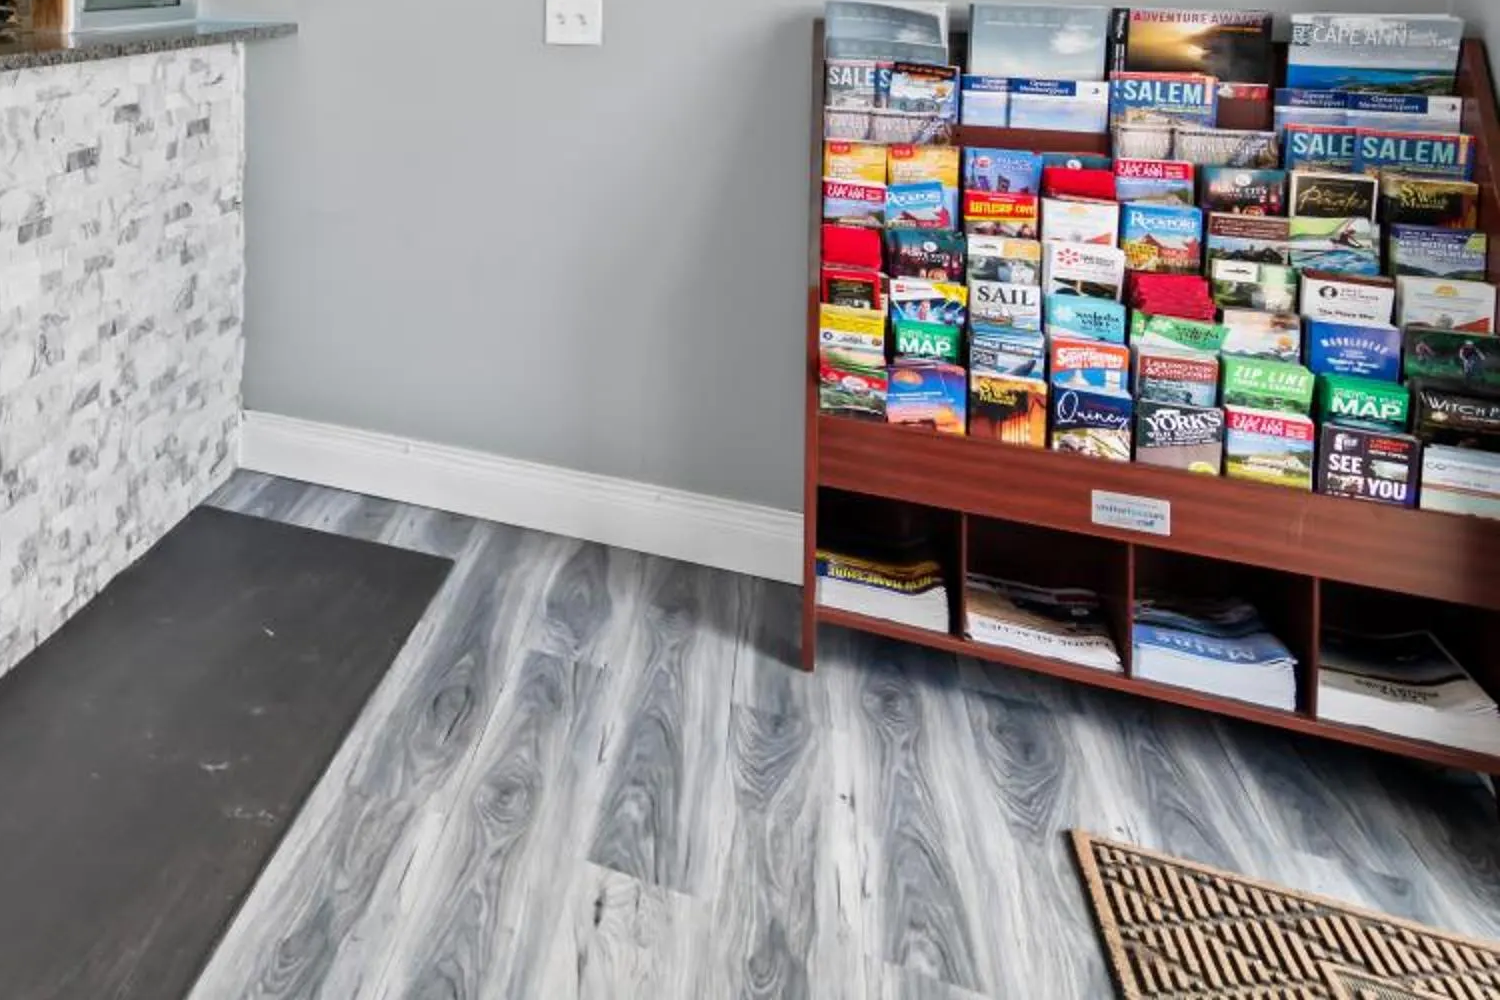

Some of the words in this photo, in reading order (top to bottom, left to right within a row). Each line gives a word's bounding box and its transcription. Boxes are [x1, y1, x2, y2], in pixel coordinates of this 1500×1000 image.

[1123, 80, 1202, 105] SALEM
[1362, 136, 1455, 164] SALEM
[978, 285, 1035, 306] SAIL
[899, 337, 951, 356] MAP
[1234, 365, 1263, 380] ZIP
[1267, 371, 1309, 388] LINE
[1331, 397, 1401, 419] MAP
[1328, 453, 1363, 474] SEE
[1367, 477, 1407, 500] YOU
